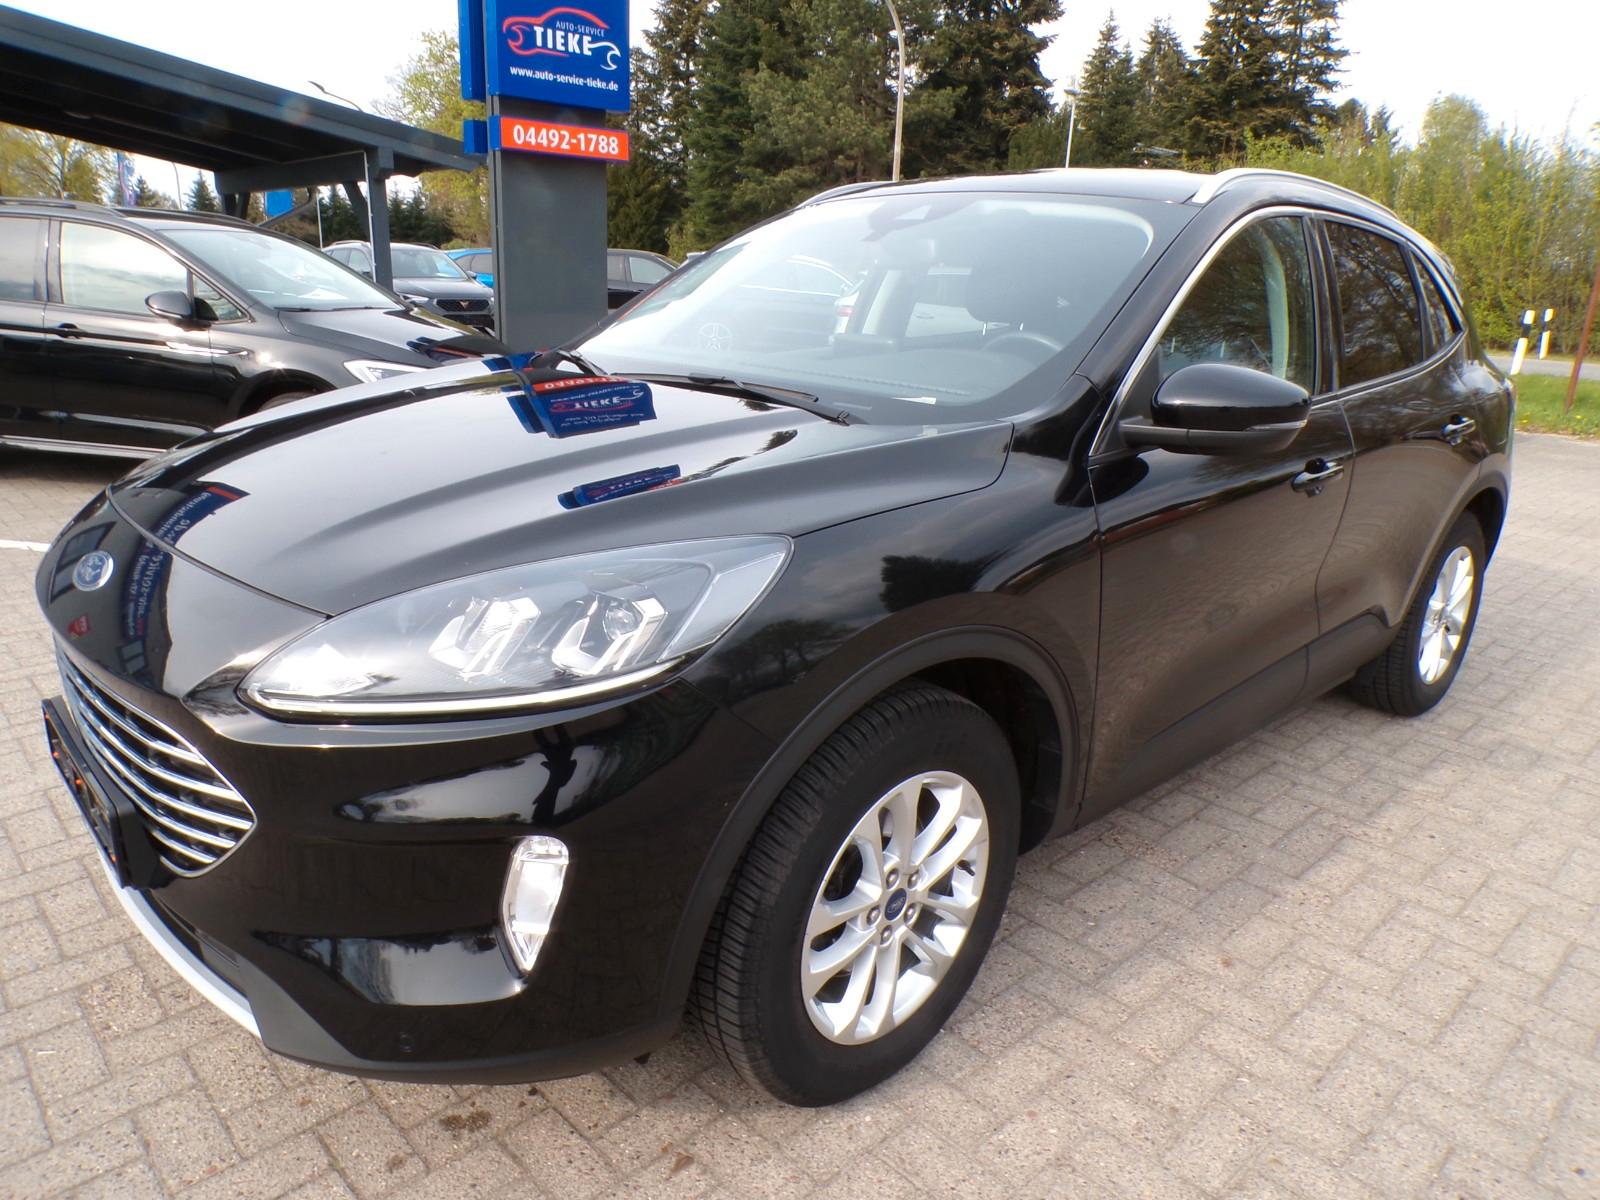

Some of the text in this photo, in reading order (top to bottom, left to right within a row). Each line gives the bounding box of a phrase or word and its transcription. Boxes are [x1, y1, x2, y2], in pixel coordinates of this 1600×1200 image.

[533, 26, 592, 56] TIEKE
[555, 20, 605, 37] AUTO-SERVICE
[509, 66, 618, 91] www.auto-service-tieke.de
[512, 124, 619, 155] 04492-1788
